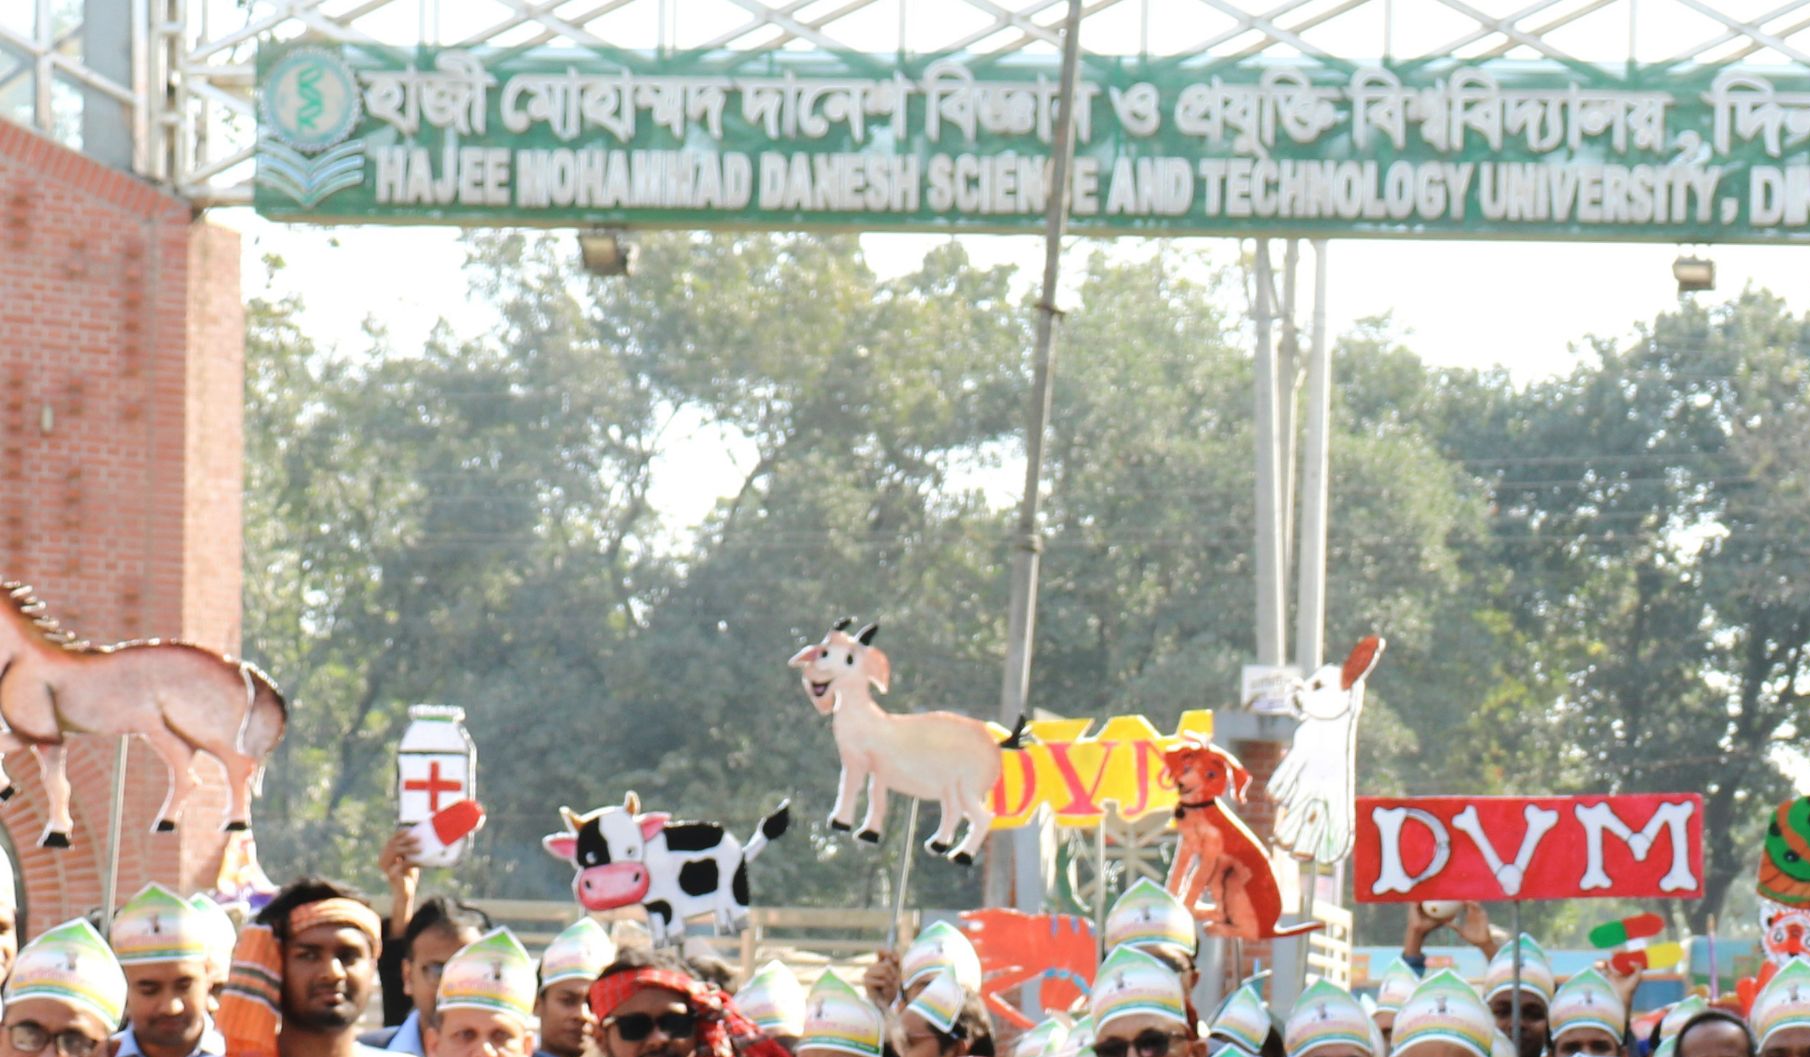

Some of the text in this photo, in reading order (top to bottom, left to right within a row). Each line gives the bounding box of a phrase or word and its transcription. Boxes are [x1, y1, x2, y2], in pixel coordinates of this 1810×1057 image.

[362, 49, 497, 136] হাজী
[500, 66, 738, 143] মোহাম্মদ
[738, 70, 916, 143] দানেশ
[1109, 82, 1161, 136] ও
[1174, 67, 1342, 162] প্রযুক্তি
[374, 145, 512, 204] HAJEE
[515, 149, 754, 210] MOHAMMAD
[758, 150, 920, 212] DANESH
[1105, 154, 1195, 216] AND
[1200, 157, 1475, 221] TECHNOLOGY
[1479, 162, 1740, 225] UNIVERSITY,
[1371, 800, 1699, 896] DVM
